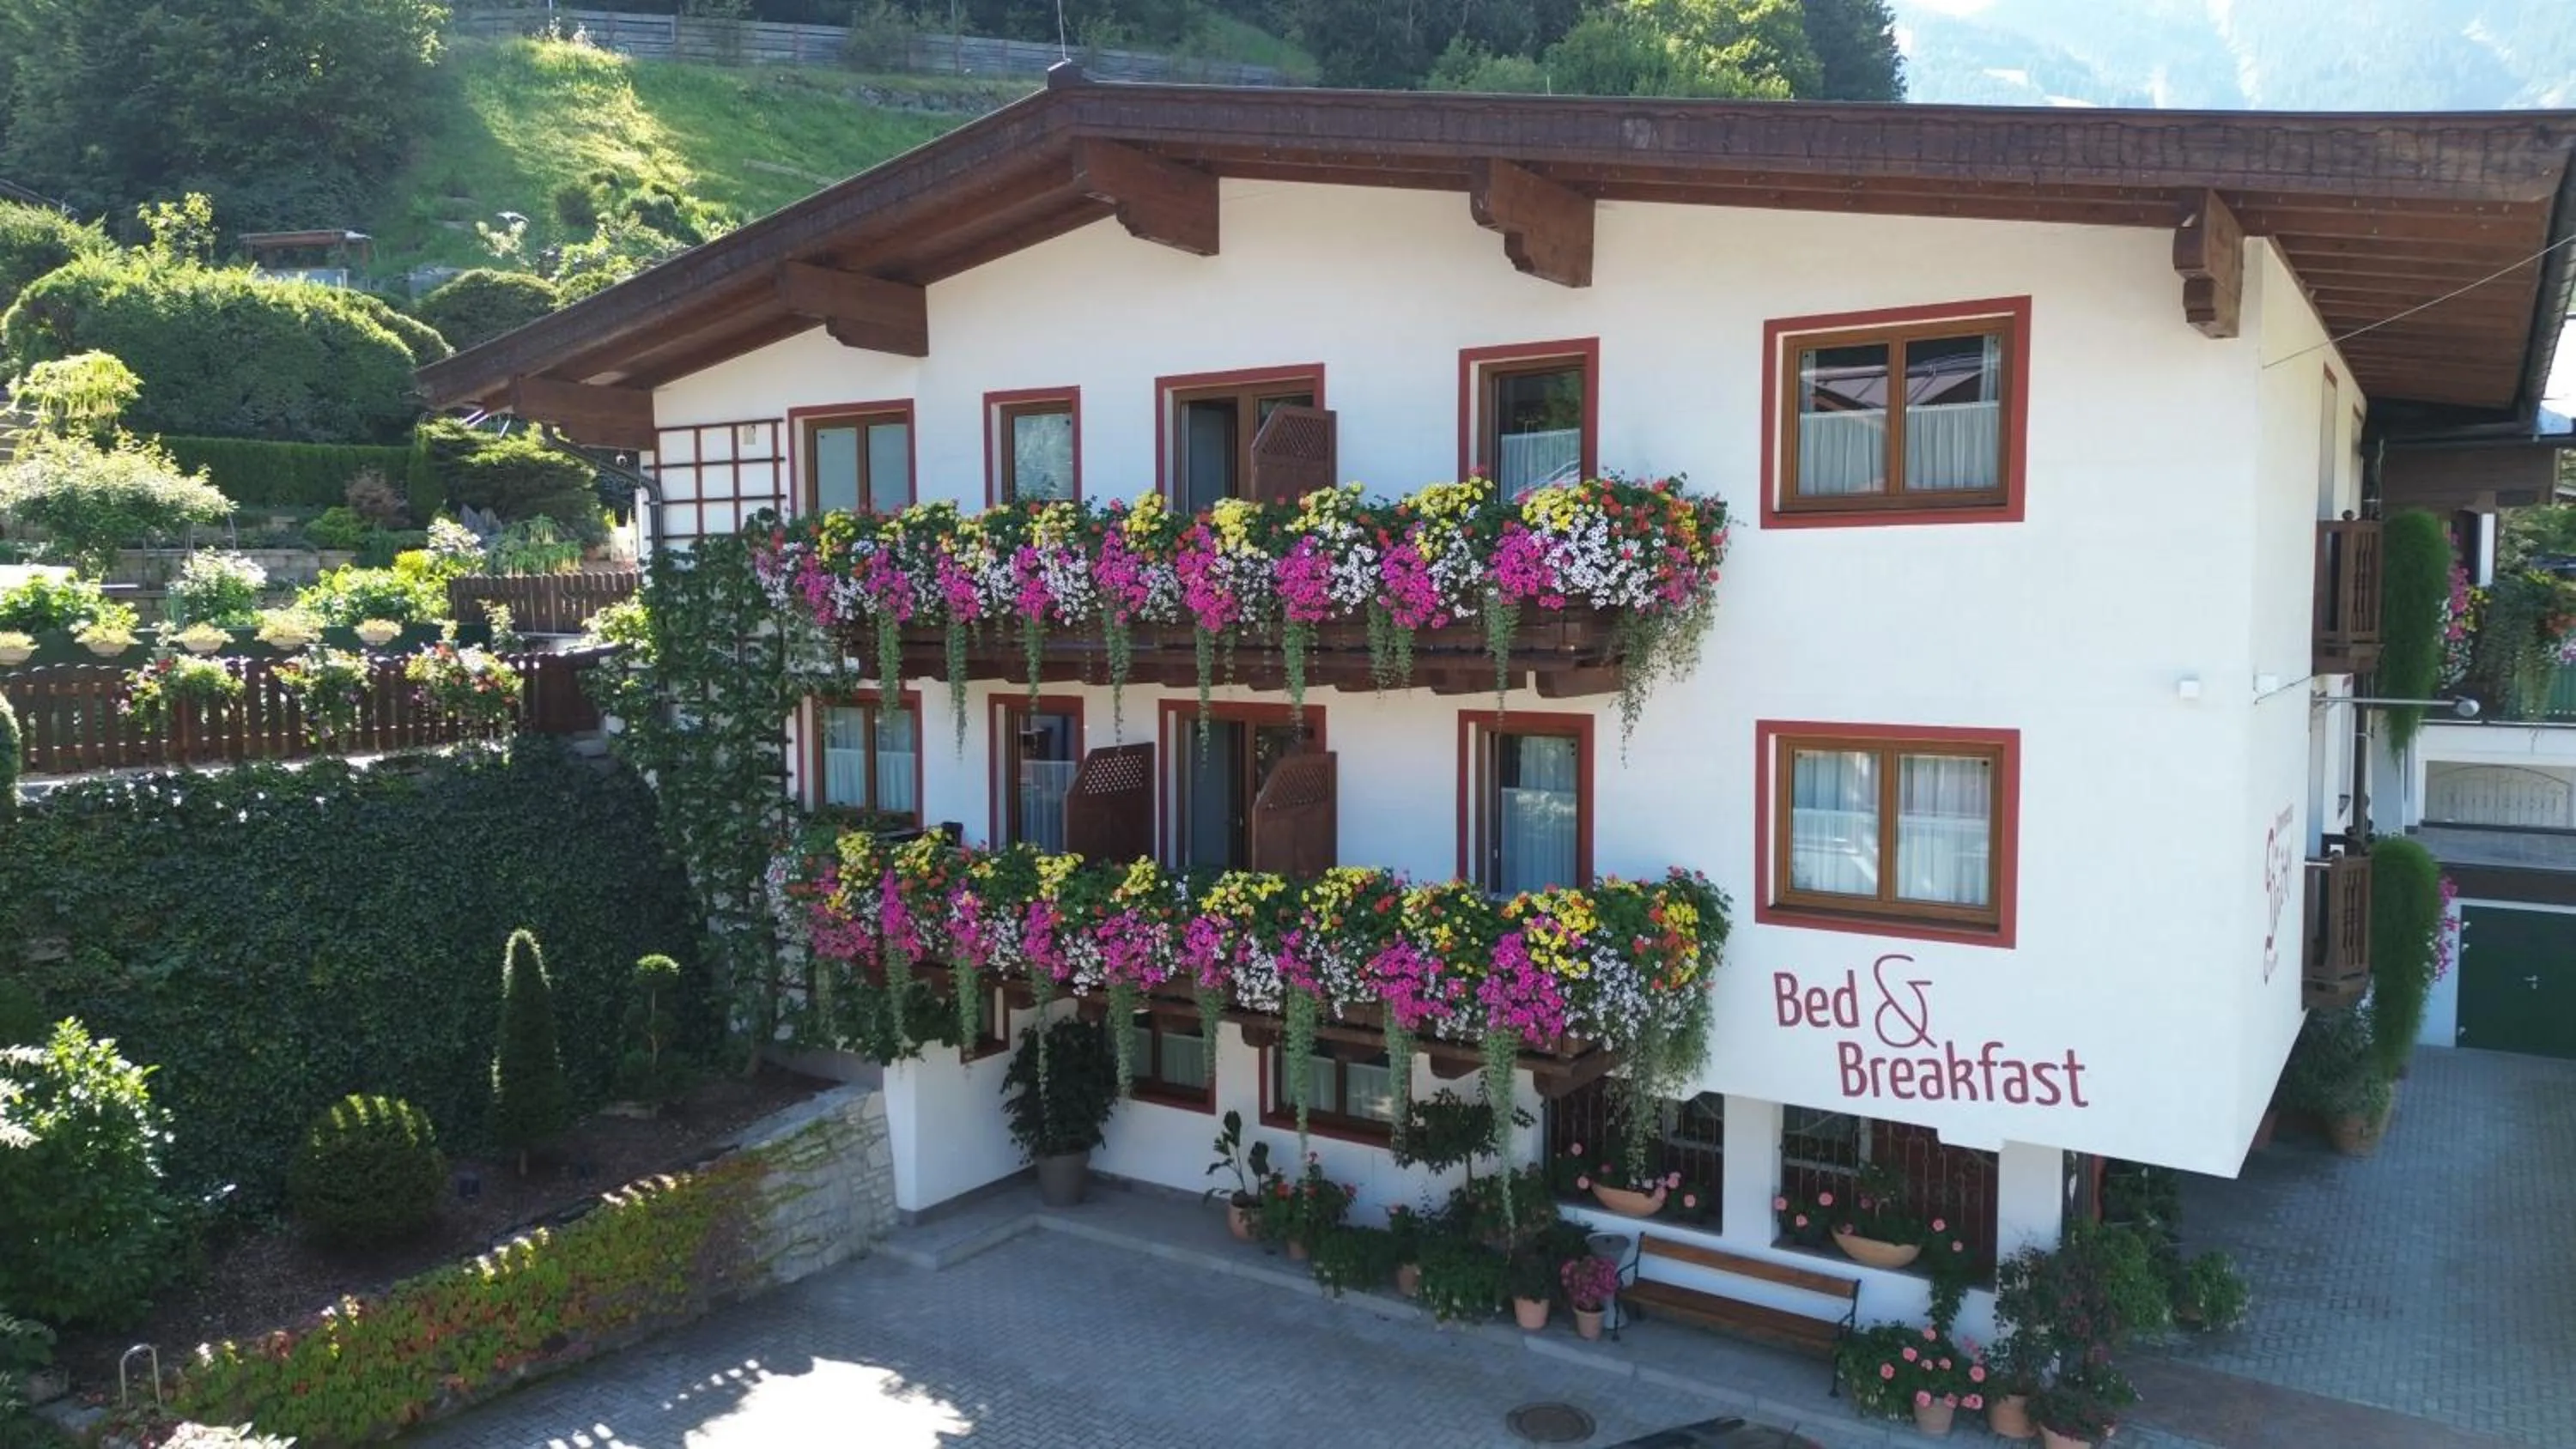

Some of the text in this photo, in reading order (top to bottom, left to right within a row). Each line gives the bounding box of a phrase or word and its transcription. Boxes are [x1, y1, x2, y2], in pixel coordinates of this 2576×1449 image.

[1773, 954, 1938, 1048] Bed &
[1837, 1040, 2089, 1108] Breakfast
